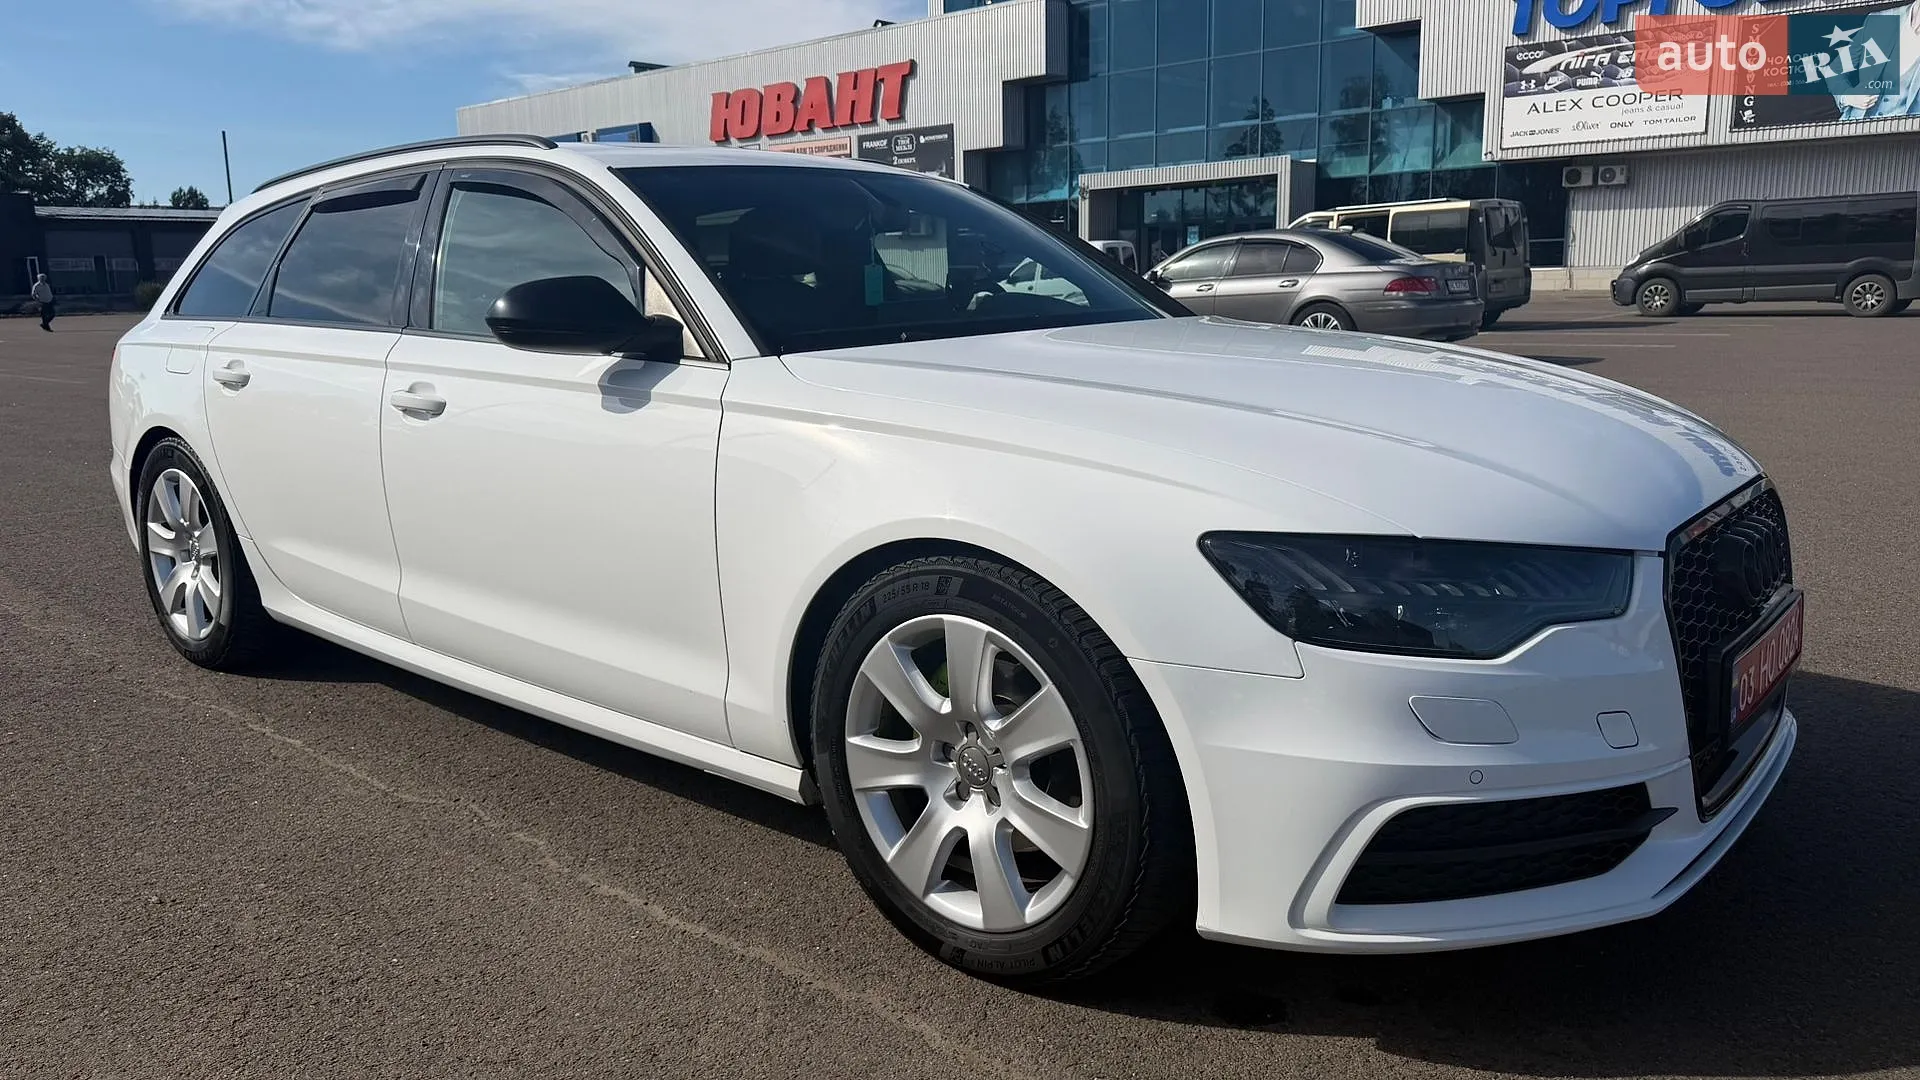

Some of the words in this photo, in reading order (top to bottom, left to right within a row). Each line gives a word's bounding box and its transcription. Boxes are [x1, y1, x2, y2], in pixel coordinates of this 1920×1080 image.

[710, 60, 914, 143] ЮВАНТ
[1527, 97, 1583, 115] ALEX
[1592, 88, 1683, 109] COOPER
[1610, 120, 1635, 130] ONLY
[1643, 118, 1665, 126] TOM
[1665, 115, 1697, 124] TAILOR
[1739, 665, 1755, 711] 03
